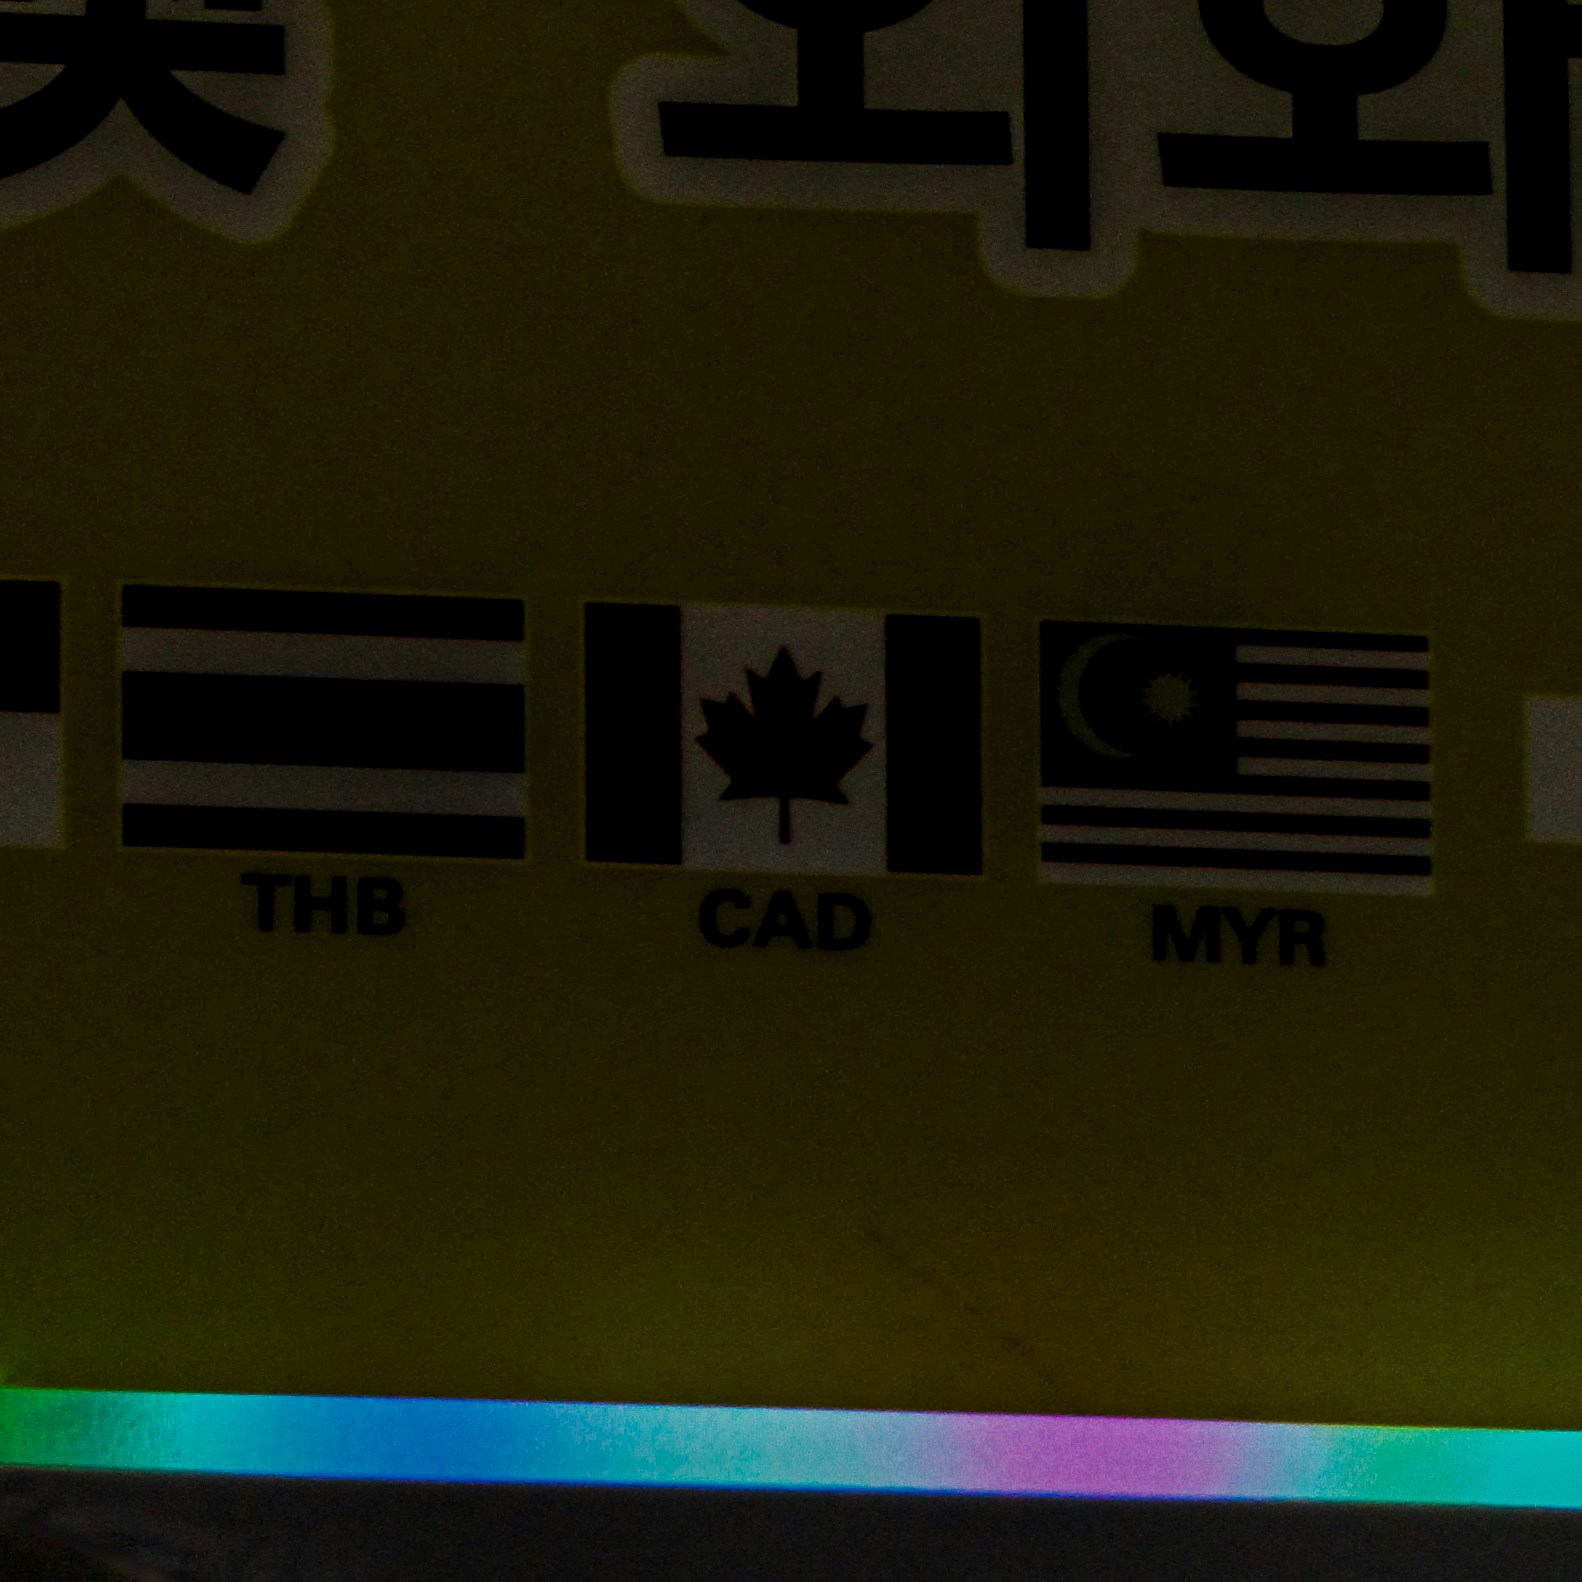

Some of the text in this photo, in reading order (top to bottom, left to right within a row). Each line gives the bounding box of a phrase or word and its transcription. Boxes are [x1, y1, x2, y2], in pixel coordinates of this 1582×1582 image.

[240, 870, 407, 937] THB
[697, 887, 873, 953] CAD
[1150, 902, 1327, 968] MYR
